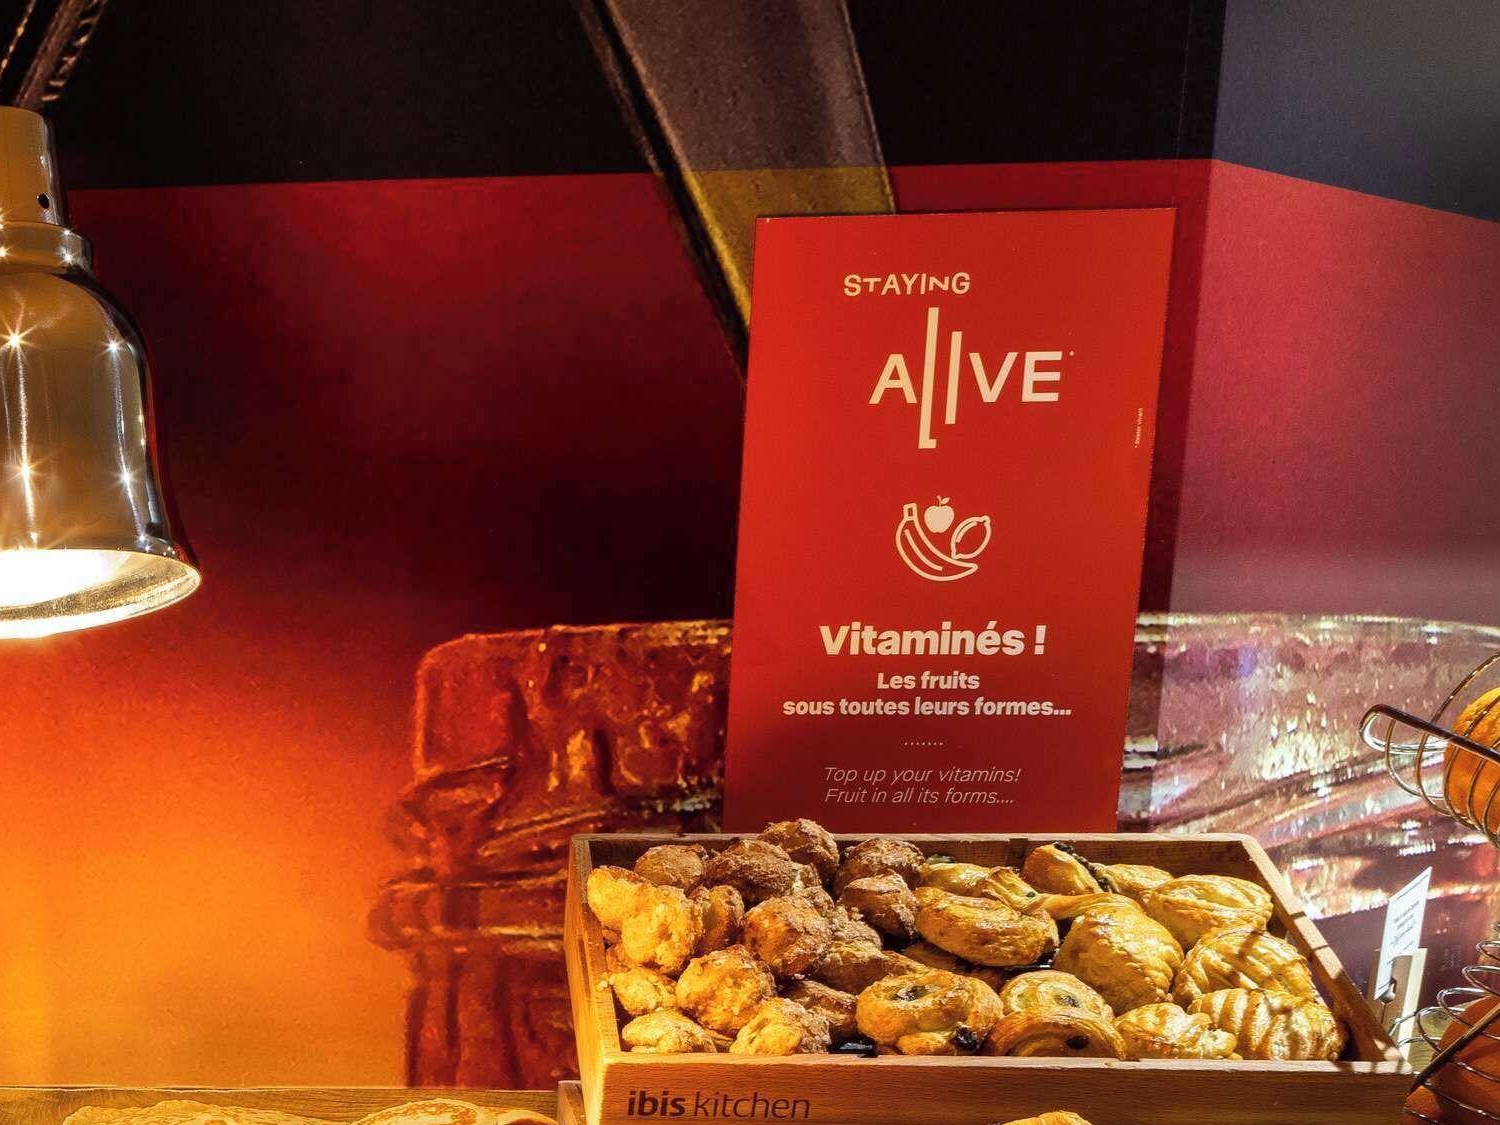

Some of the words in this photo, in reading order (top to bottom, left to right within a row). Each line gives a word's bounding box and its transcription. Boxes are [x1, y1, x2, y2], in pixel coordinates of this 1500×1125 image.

[843, 271, 971, 296] STAYING
[818, 620, 1026, 656] Vitaminés
[1034, 624, 1047, 655] !
[877, 672, 916, 689] Les
[920, 670, 980, 689] fruits
[783, 699, 835, 716] sous
[839, 698, 910, 716] toutes
[914, 696, 970, 716] leurs
[974, 696, 1072, 716] formes...
[824, 766, 858, 785] Top
[863, 769, 887, 785] up
[890, 769, 934, 786] your
[939, 765, 1022, 783] vitamins!
[825, 787, 867, 803] Fruit
[871, 787, 887, 803] in
[892, 787, 915, 803] all
[917, 787, 939, 804] its
[627, 1090, 686, 1117] ibis
[692, 1090, 811, 1119] kitchen
